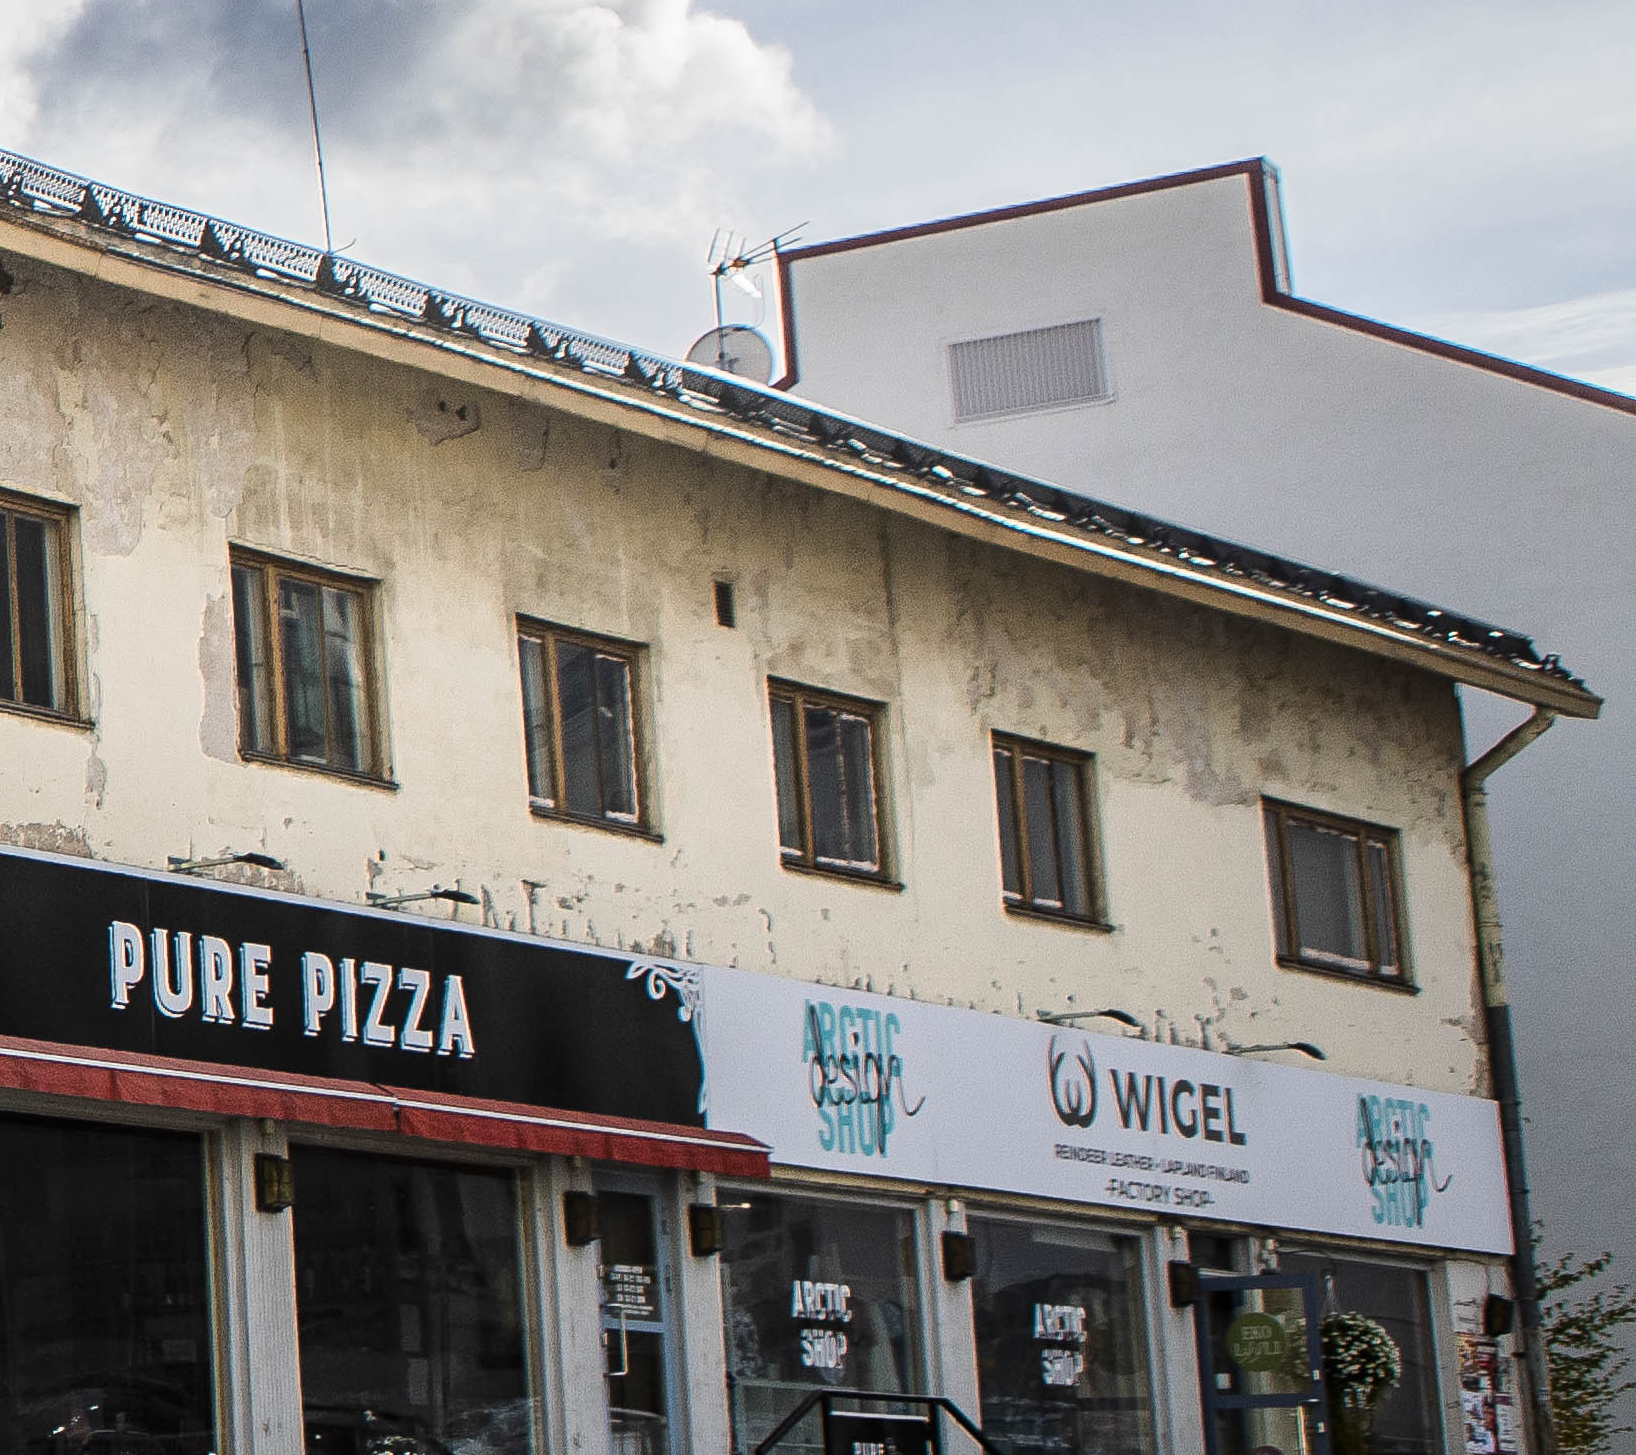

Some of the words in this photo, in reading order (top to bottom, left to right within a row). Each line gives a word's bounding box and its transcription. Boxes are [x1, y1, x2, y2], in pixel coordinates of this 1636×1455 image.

[108, 920, 274, 1031] PURE
[301, 951, 475, 1059] PIZZA
[1107, 1068, 1248, 1146] WIGEL
